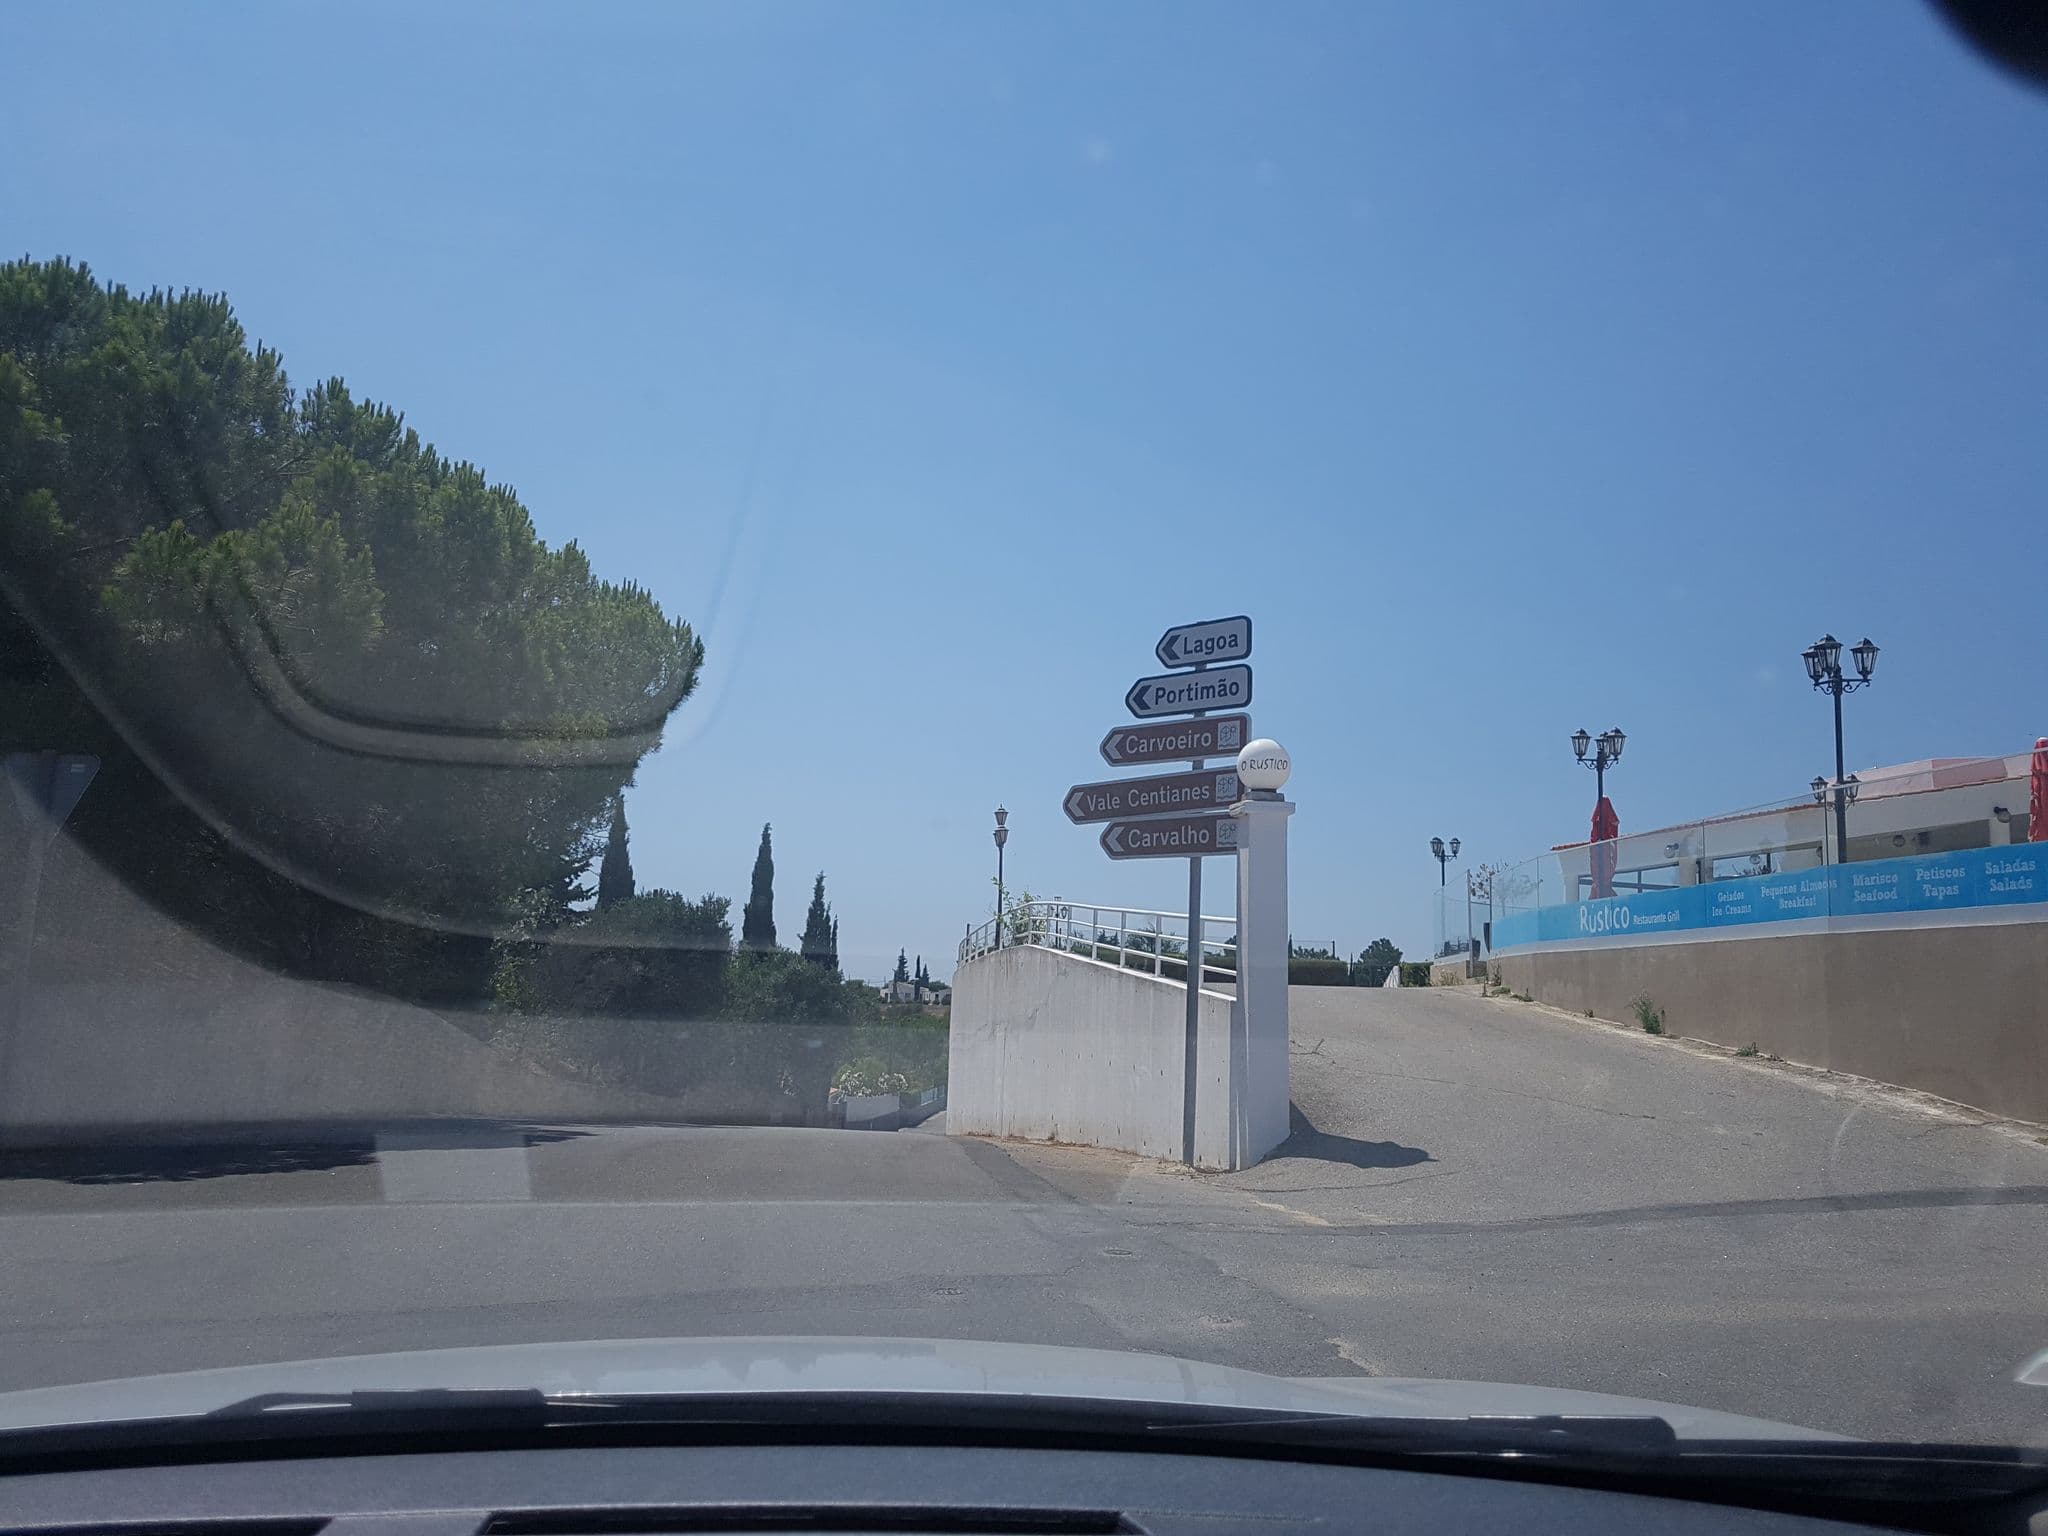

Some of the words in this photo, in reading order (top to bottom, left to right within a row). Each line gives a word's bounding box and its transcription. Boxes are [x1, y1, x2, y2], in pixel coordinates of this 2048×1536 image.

[1183, 633, 1239, 656] Lagoa
[1154, 678, 1240, 706] Portimão
[1125, 730, 1212, 754] Carvoeiro
[1241, 760, 1247, 771] O
[1249, 758, 1288, 770] RUSTICO
[1086, 793, 1121, 812] Vale
[1127, 784, 1210, 808] Centianes
[1127, 825, 1210, 848] Carvalho
[1914, 867, 1966, 882] Petiscos
[1984, 859, 2036, 876] Saladas
[1852, 872, 1899, 888] Marisco
[1989, 876, 2033, 893] Salads
[1761, 884, 1797, 899] Pequenos
[1853, 888, 1899, 903] Seafood
[1922, 884, 1959, 899] Tapas
[1712, 906, 1723, 917] Ice
[1725, 904, 1752, 915] Creams
